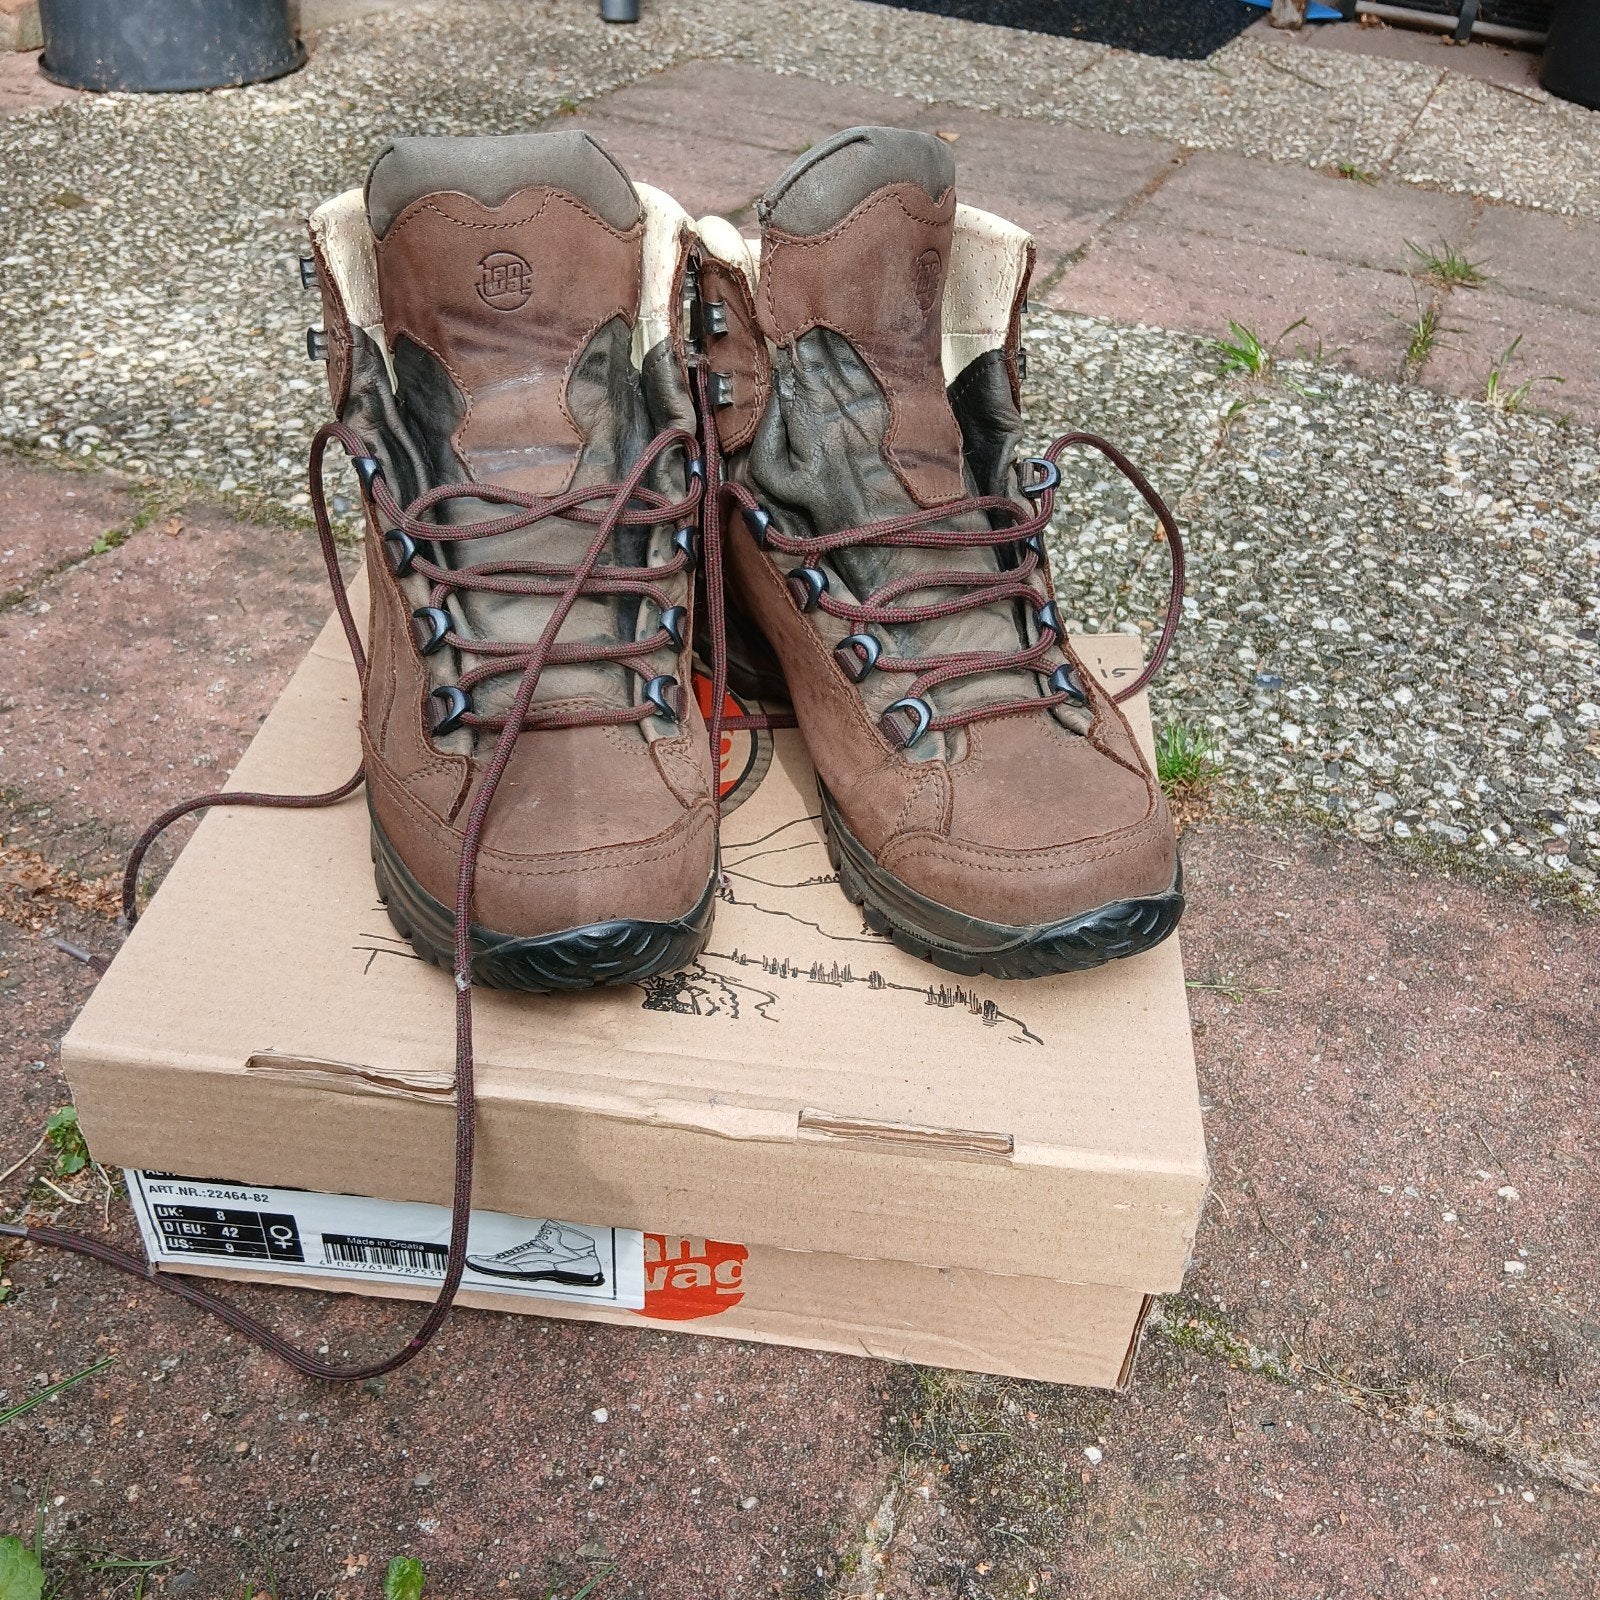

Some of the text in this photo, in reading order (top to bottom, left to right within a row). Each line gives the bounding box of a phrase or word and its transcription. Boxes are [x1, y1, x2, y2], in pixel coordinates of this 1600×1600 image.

[149, 1184, 270, 1203] ART.NR.:22464-82
[157, 1206, 226, 1222] UK: 8
[221, 1226, 240, 1239] 42
[168, 1238, 235, 1254] US: 9
[346, 1237, 425, 1251] Made in Croatia
